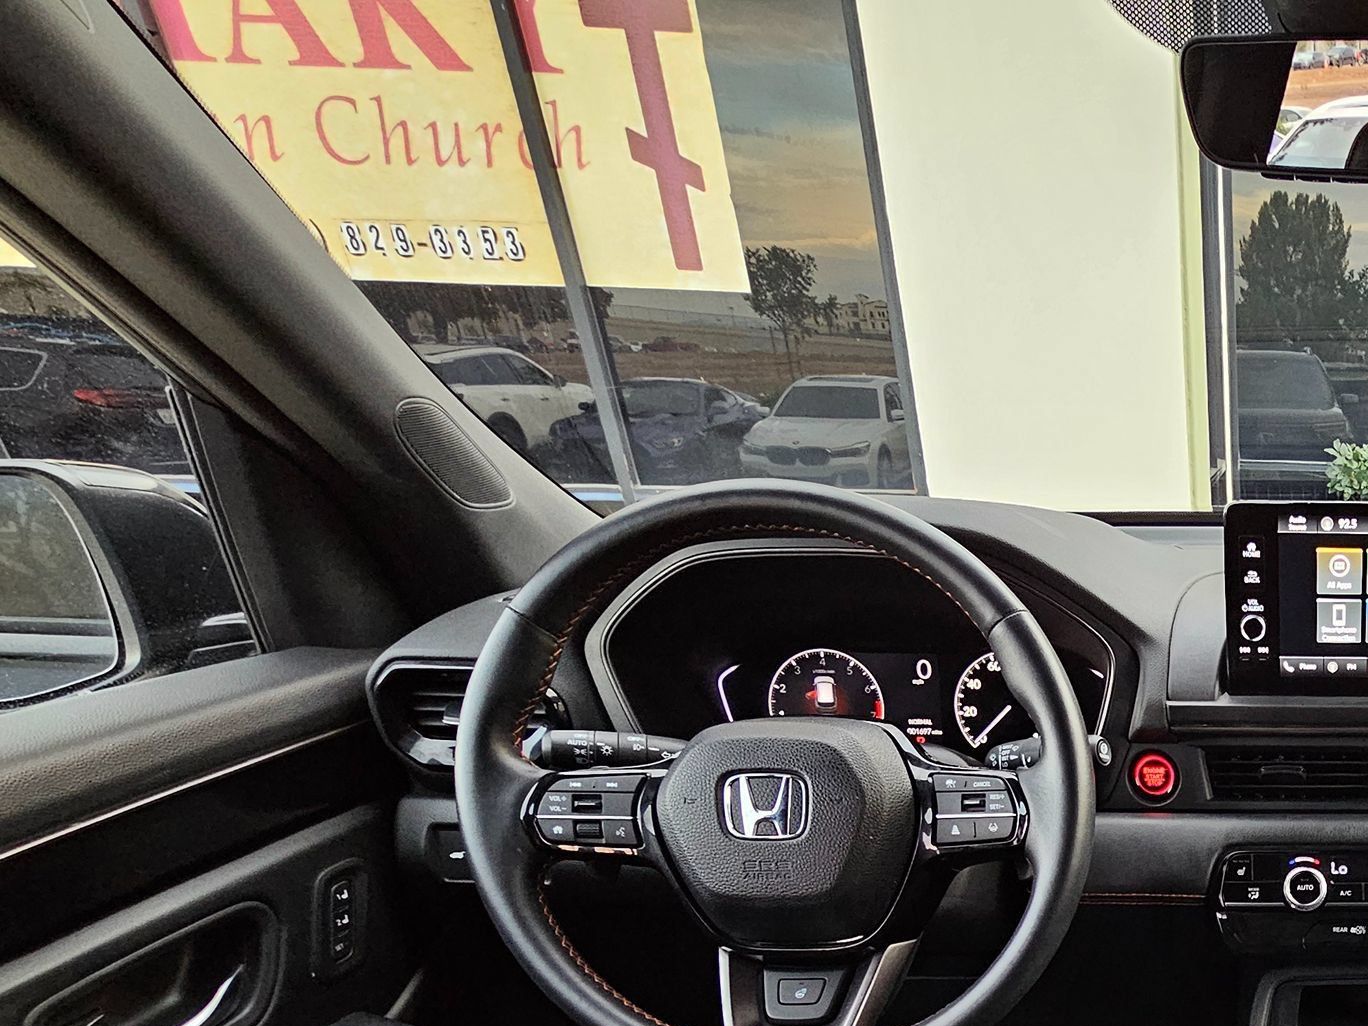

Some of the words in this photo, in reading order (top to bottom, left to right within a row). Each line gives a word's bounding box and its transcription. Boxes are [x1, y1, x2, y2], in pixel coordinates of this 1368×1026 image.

[342, 221, 525, 261] 829-3353
[820, 658, 826, 666] 4
[795, 667, 801, 675] 3
[847, 667, 853, 675] 5
[916, 659, 932, 680] 0
[966, 678, 982, 690] 40
[779, 685, 786, 693] 2
[865, 686, 871, 694] 6
[962, 706, 978, 717] 20
